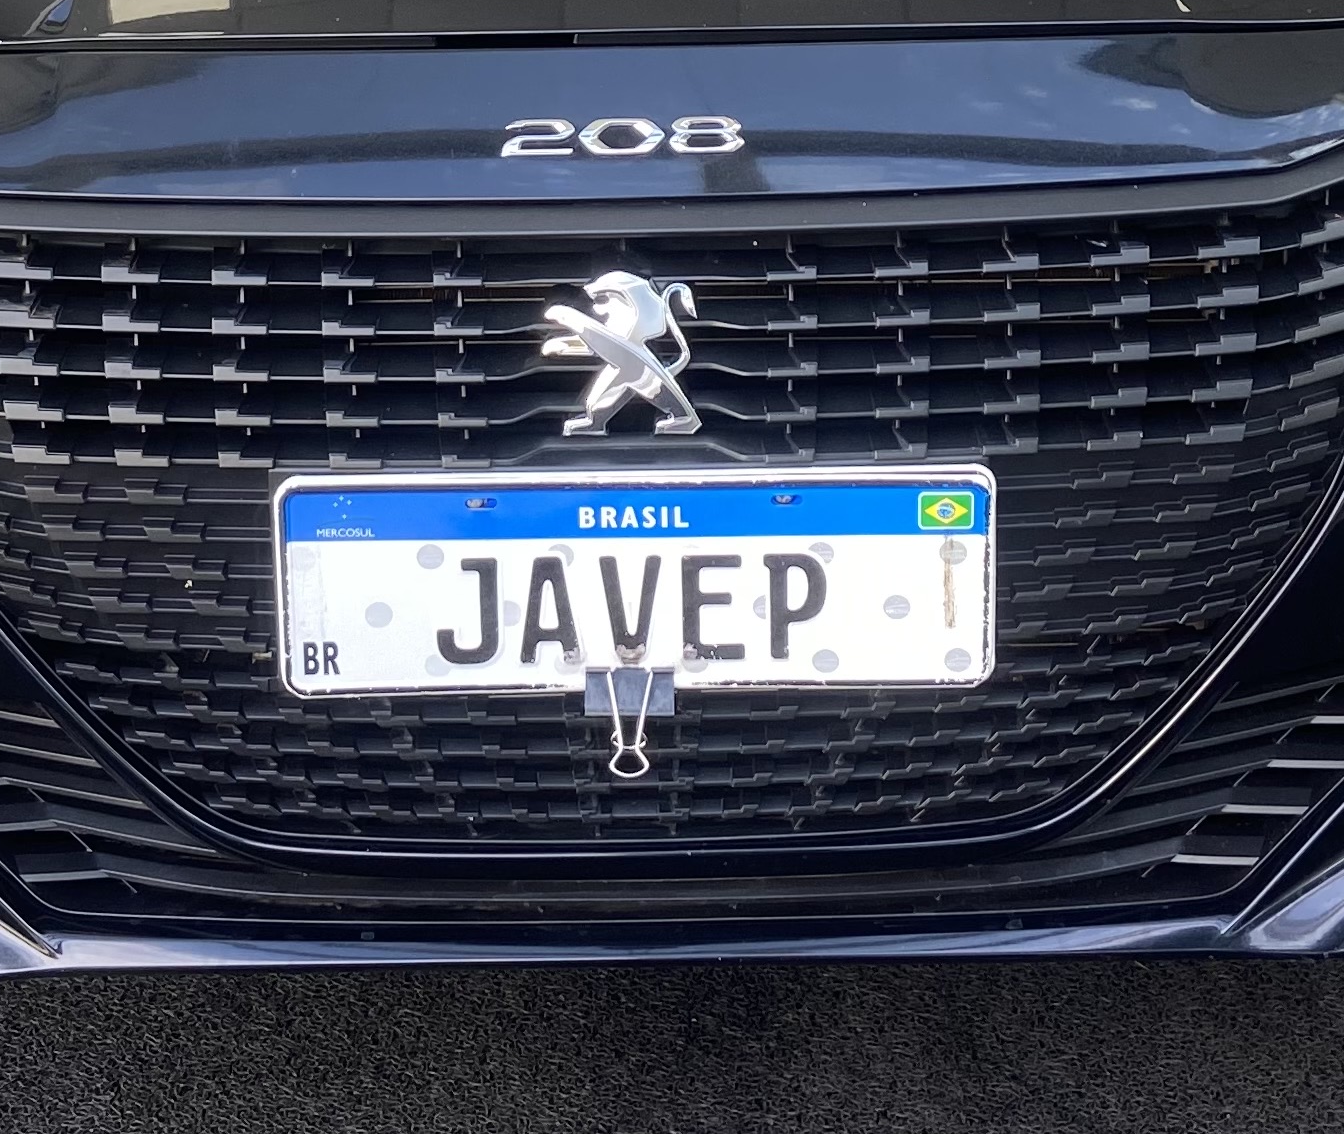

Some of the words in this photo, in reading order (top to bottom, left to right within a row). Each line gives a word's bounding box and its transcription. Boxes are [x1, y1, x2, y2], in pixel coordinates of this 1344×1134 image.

[501, 115, 746, 157] 208
[316, 527, 376, 539] MERCOSUL
[578, 505, 690, 529] BRASIL
[436, 552, 828, 665] JAVEP
[302, 641, 341, 677] BR
